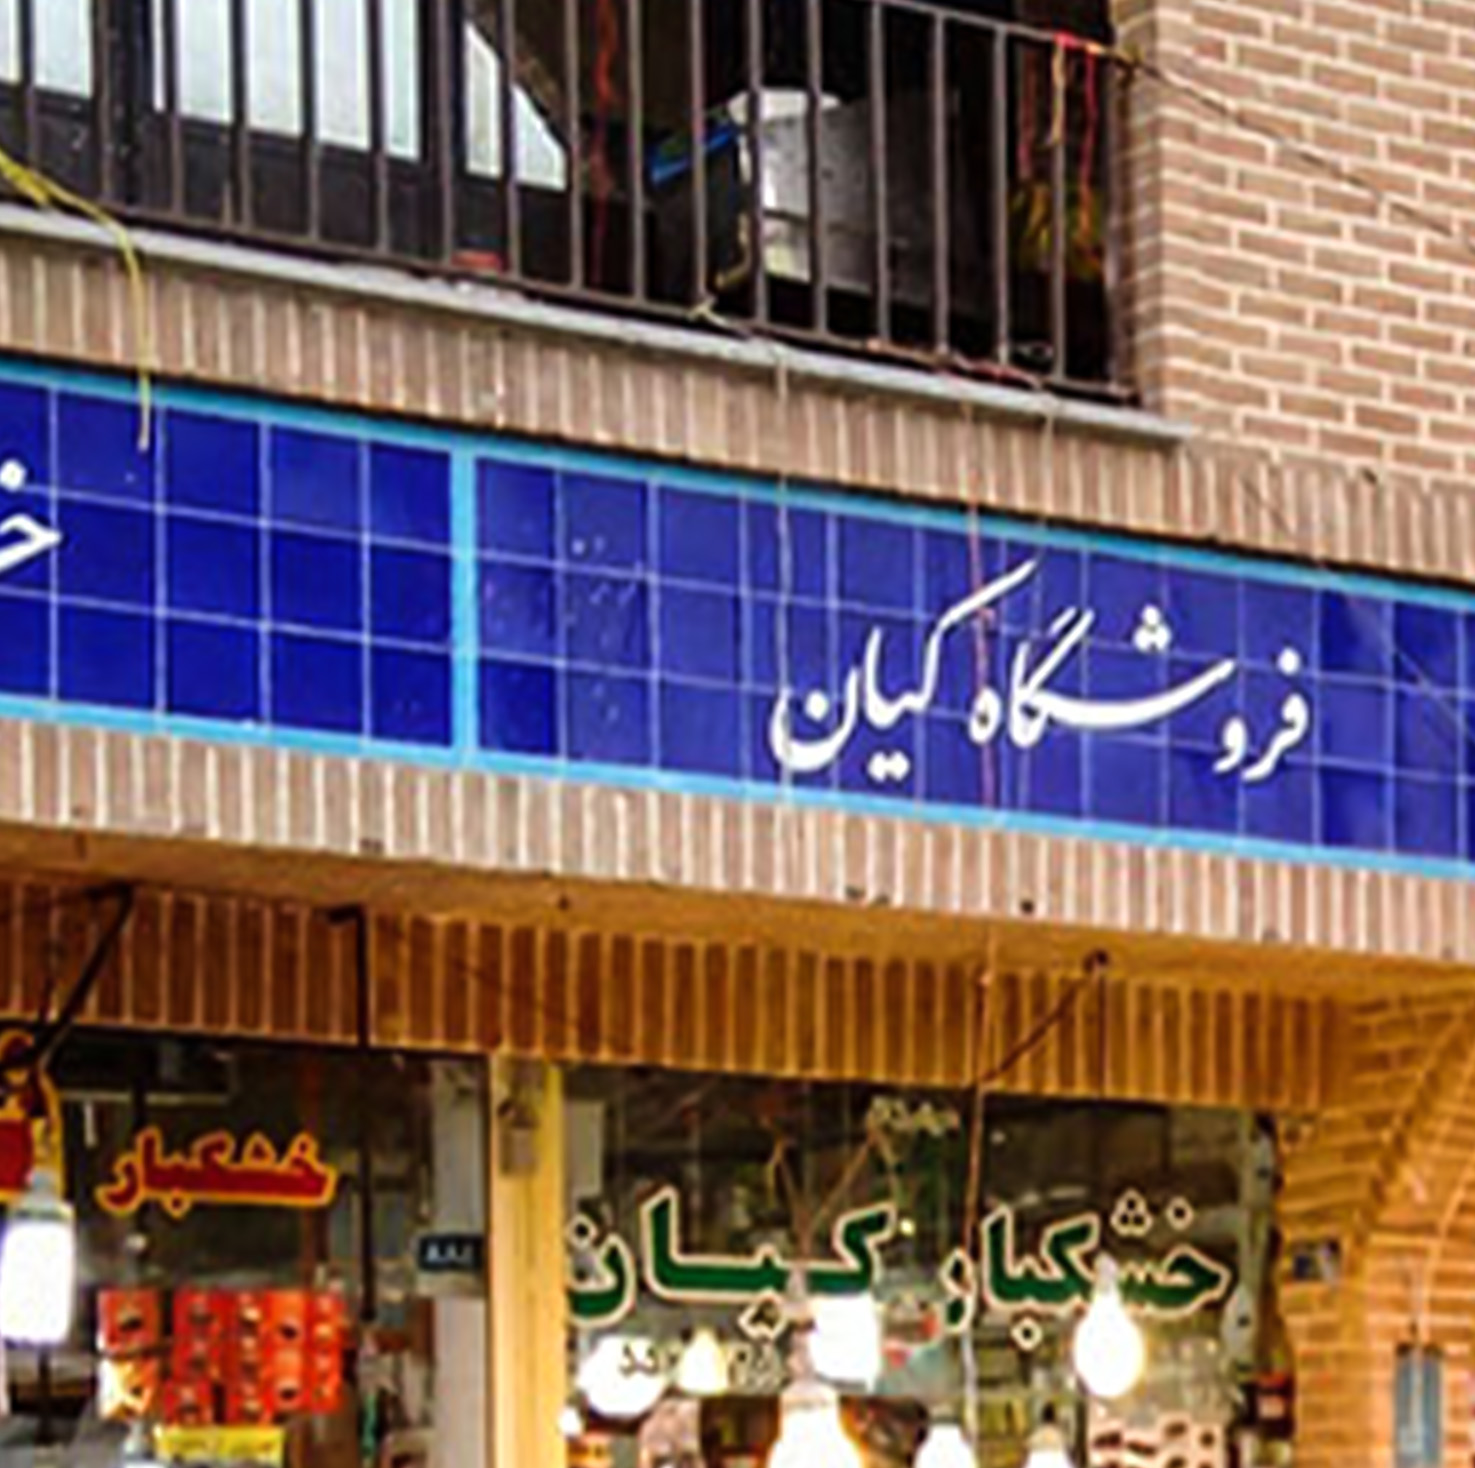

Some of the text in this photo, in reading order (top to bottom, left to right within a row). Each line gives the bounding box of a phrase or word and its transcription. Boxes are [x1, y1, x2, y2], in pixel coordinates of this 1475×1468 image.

[769, 557, 1310, 782] فروشگاه کیان
[95, 1125, 339, 1219] خشکبار
